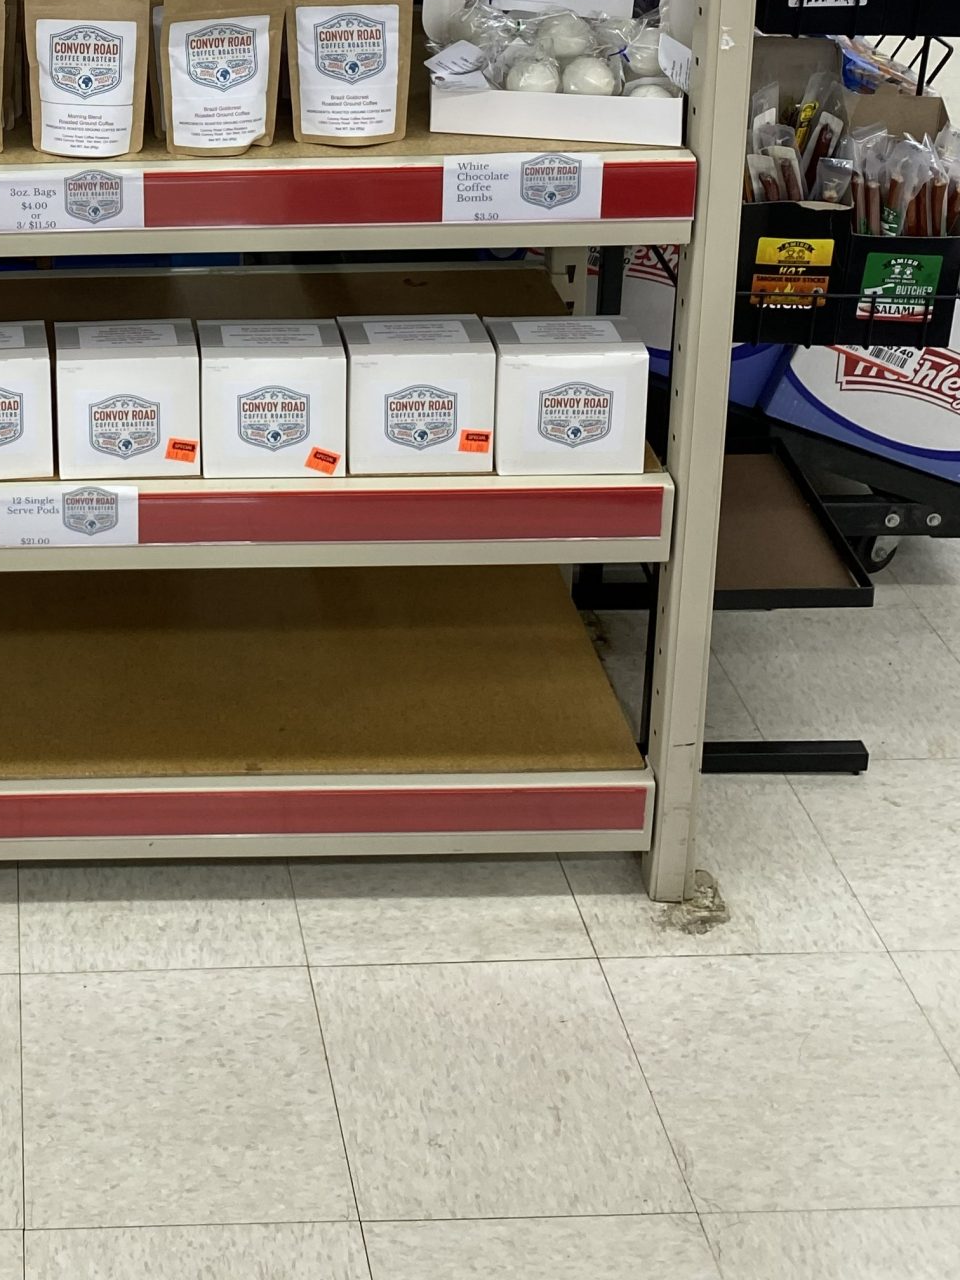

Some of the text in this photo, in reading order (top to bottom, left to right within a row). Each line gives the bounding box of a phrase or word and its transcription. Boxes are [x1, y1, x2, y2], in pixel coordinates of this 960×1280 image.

[458, 162, 490, 171] White
[457, 172, 510, 182] Chocolate
[456, 182, 491, 192] Coffee
[10, 188, 57, 199] 3oz. Bags
[456, 193, 493, 202] Bombs
[21, 202, 48, 211] $4.00
[31, 212, 41, 220] or
[474, 212, 499, 222] $3.50
[28, 220, 57, 230] $11.50
[876, 305, 916, 314] SALAMI
[242, 401, 306, 412] CONVOY ROAD
[24, 496, 55, 506] Single
[7, 506, 60, 514] Serve Pods
